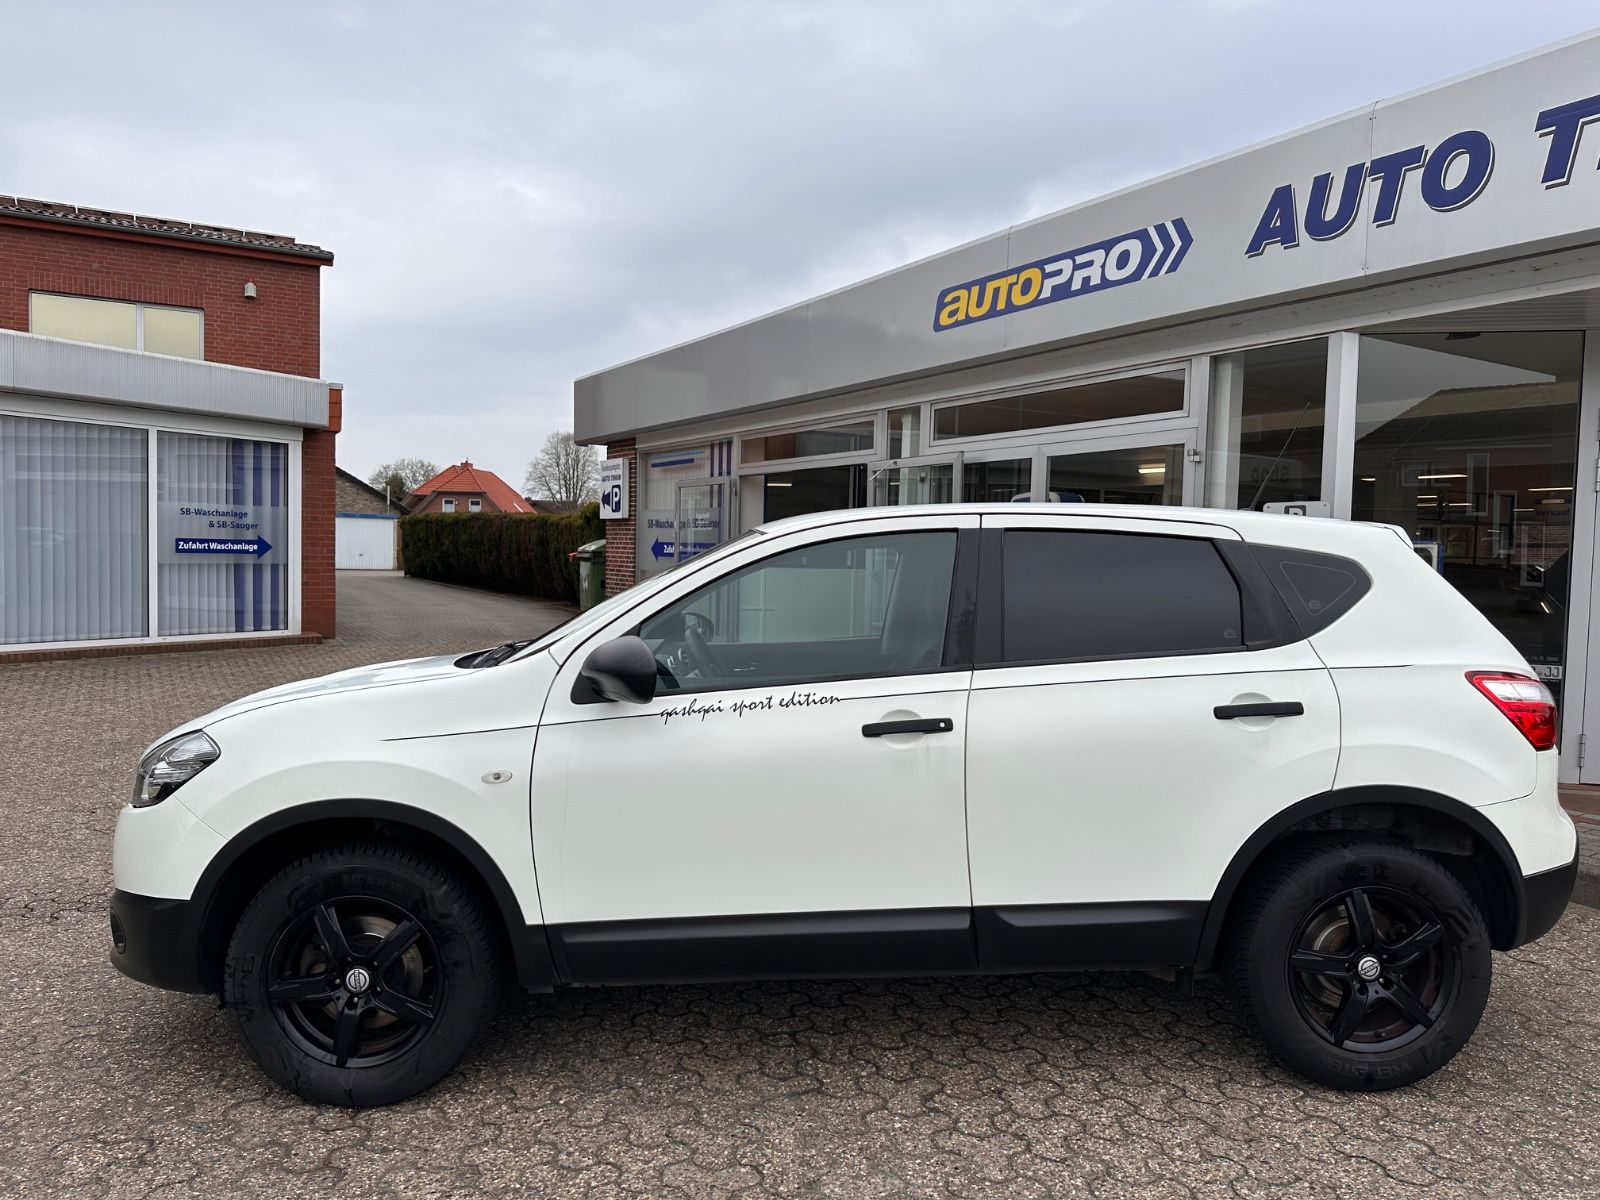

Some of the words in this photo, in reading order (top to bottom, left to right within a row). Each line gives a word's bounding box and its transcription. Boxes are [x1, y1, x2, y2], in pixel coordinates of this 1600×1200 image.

[1244, 130, 1496, 259] AUTO
[1534, 94, 1600, 191] T
[180, 507, 248, 519] SB-Waschanlage
[208, 520, 215, 528] &
[217, 521, 259, 531] SB-Sauger
[178, 541, 209, 550] Zufahrt
[209, 542, 258, 552] Waschanlage
[660, 697, 725, 725] qashqai
[730, 694, 774, 718] sport
[779, 690, 841, 709] edition
